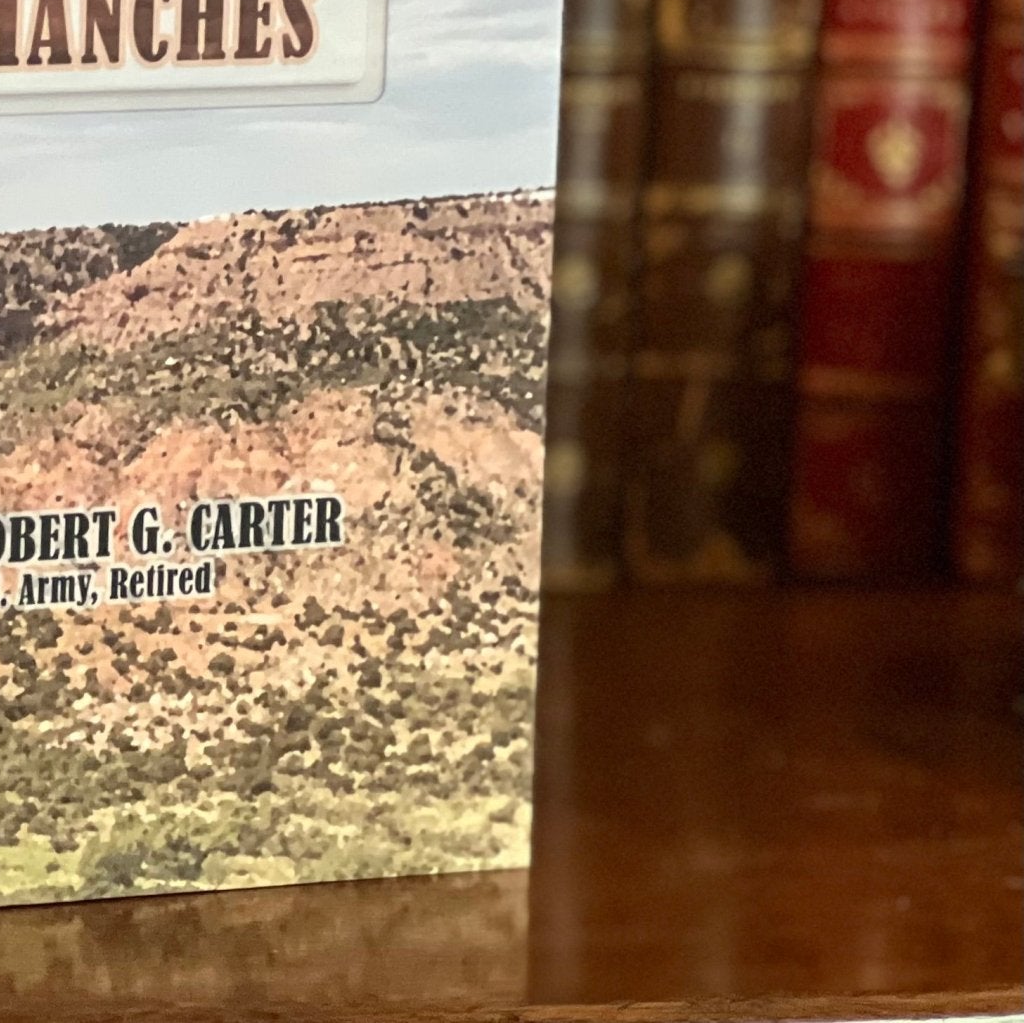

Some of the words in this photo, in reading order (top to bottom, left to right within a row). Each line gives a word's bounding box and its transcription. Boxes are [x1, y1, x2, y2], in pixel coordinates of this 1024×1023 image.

[132, 507, 173, 555] G.
[190, 496, 342, 551] CARTER
[19, 574, 99, 607] Army,
[110, 562, 212, 600] Retired
